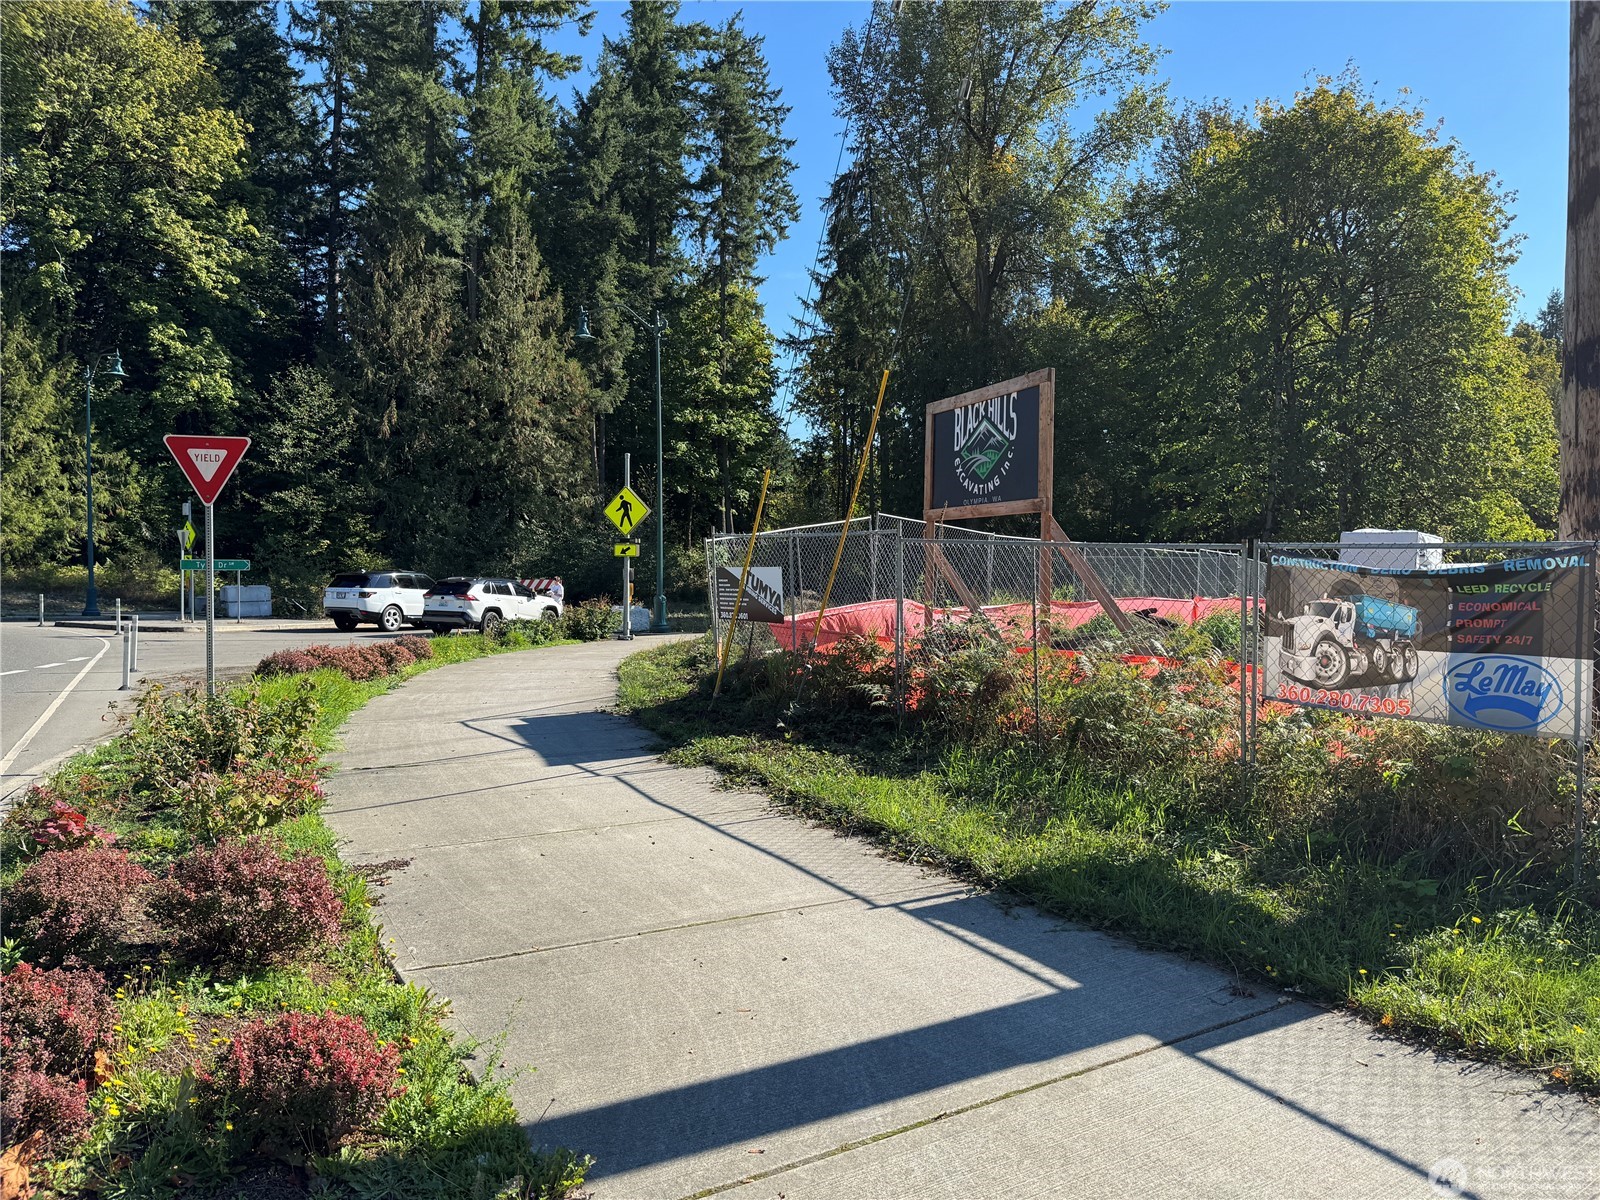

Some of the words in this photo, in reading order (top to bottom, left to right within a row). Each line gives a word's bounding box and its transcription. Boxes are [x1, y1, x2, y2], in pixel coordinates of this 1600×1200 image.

[954, 400, 986, 452] BLACK
[987, 391, 1018, 441] HILLS
[194, 453, 220, 463] YIELD
[1271, 555, 1358, 573] CONSTRUCTION
[1503, 555, 1590, 572] REMOVAL
[1456, 584, 1489, 594] LEED
[1494, 582, 1552, 593] RECYCLE
[1458, 601, 1541, 612] ECONOMICAL
[1455, 618, 1508, 628] PROMPT
[1456, 634, 1501, 644] SAFETY
[1504, 635, 1534, 645] 24/7
[1453, 661, 1552, 705] LeMay
[1277, 683, 1412, 716] 360.280.7305
